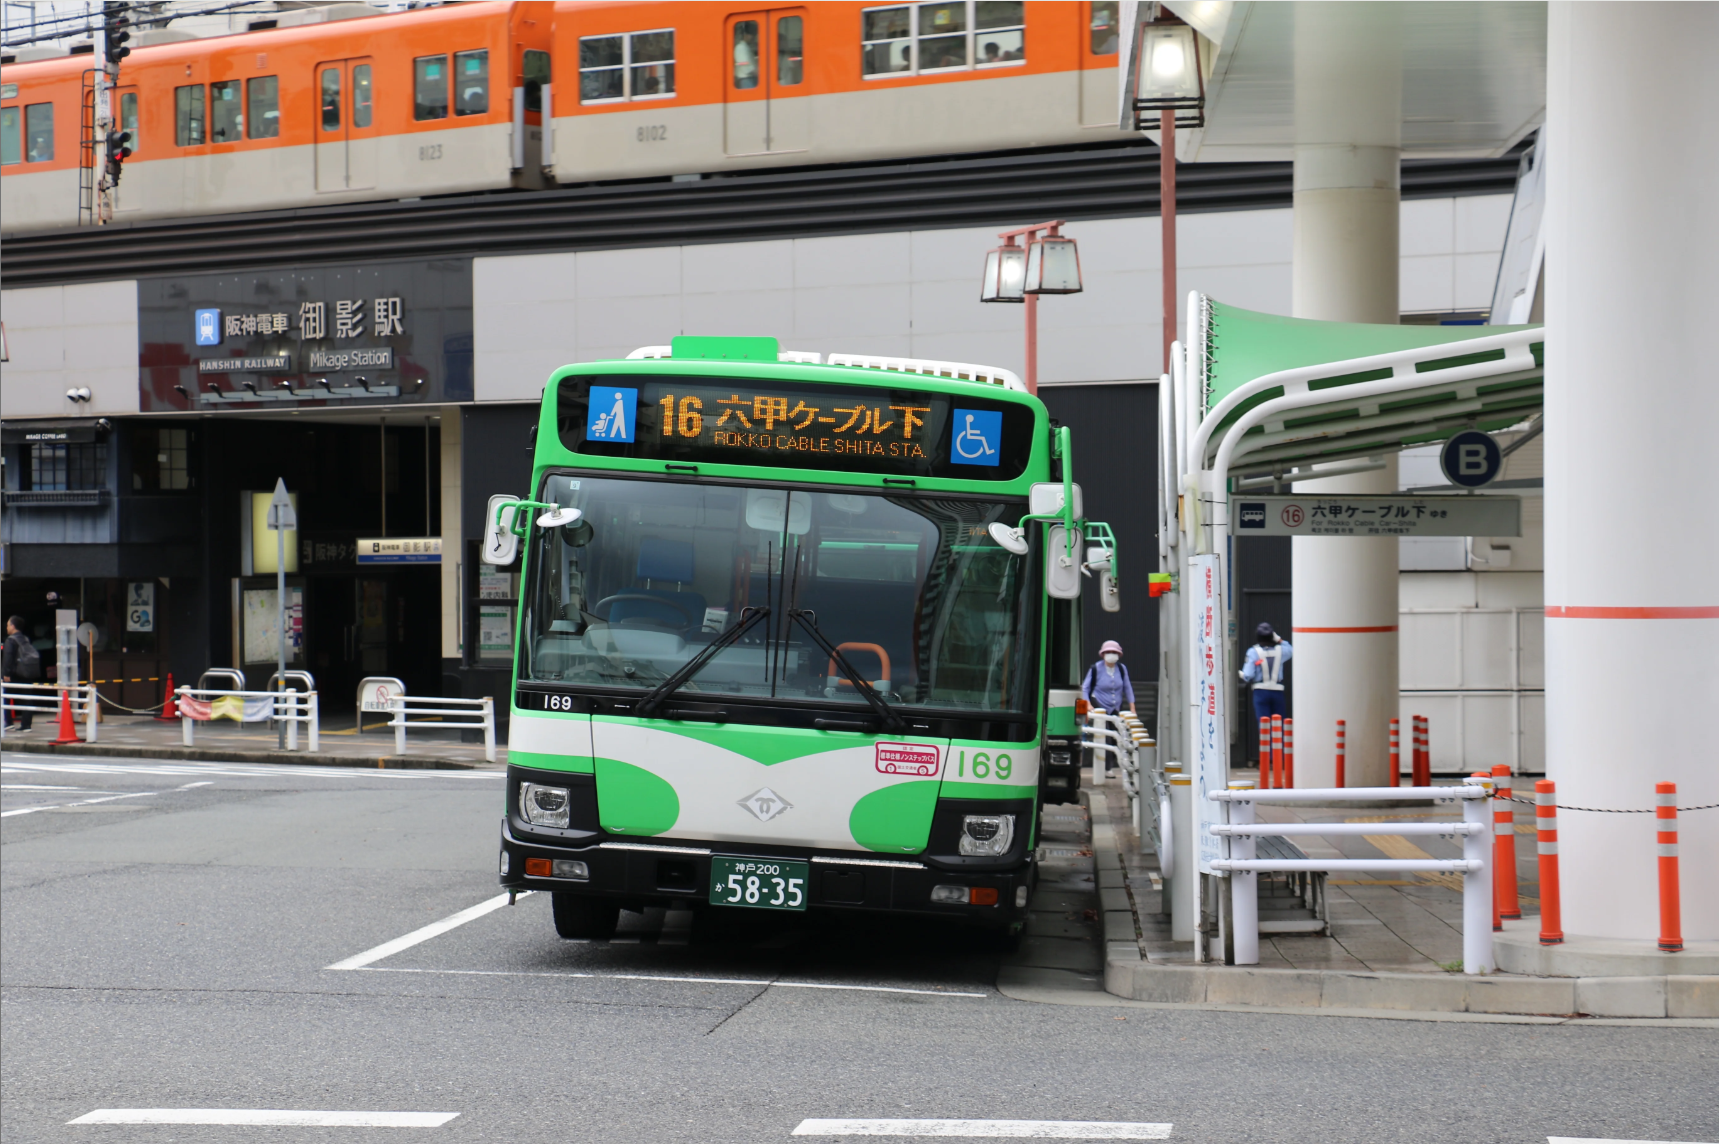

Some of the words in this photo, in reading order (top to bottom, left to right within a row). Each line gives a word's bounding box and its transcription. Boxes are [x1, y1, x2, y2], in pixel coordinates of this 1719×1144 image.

[636, 124, 668, 142] 8102
[418, 144, 443, 161] 8123
[225, 312, 289, 336] 阪神電車
[299, 297, 404, 340] 御影駅
[200, 359, 241, 371] HANSHIN
[244, 357, 286, 369] RAILWAY
[310, 352, 348, 370] Mikage
[351, 350, 389, 366] Station
[659, 394, 703, 437] 16
[715, 394, 931, 439] 六甲ケーブル下
[714, 431, 771, 449] ROKKO
[776, 435, 830, 452] CABLE
[834, 439, 884, 455] SHITA
[889, 442, 927, 458] STA.
[1459, 444, 1488, 475] B
[1285, 510, 1301, 523] 16
[1311, 505, 1427, 519] 六甲ケーブル下
[1429, 510, 1448, 519] ゆき
[1311, 519, 1323, 527] For
[1327, 519, 1350, 527] Rokko
[1354, 519, 1375, 527] Cable
[544, 694, 572, 711] 169
[880, 751, 935, 763] 標準仕様ノンステップバス
[958, 750, 1012, 780] 169
[715, 882, 725, 893] か
[727, 873, 804, 907] 58-35
